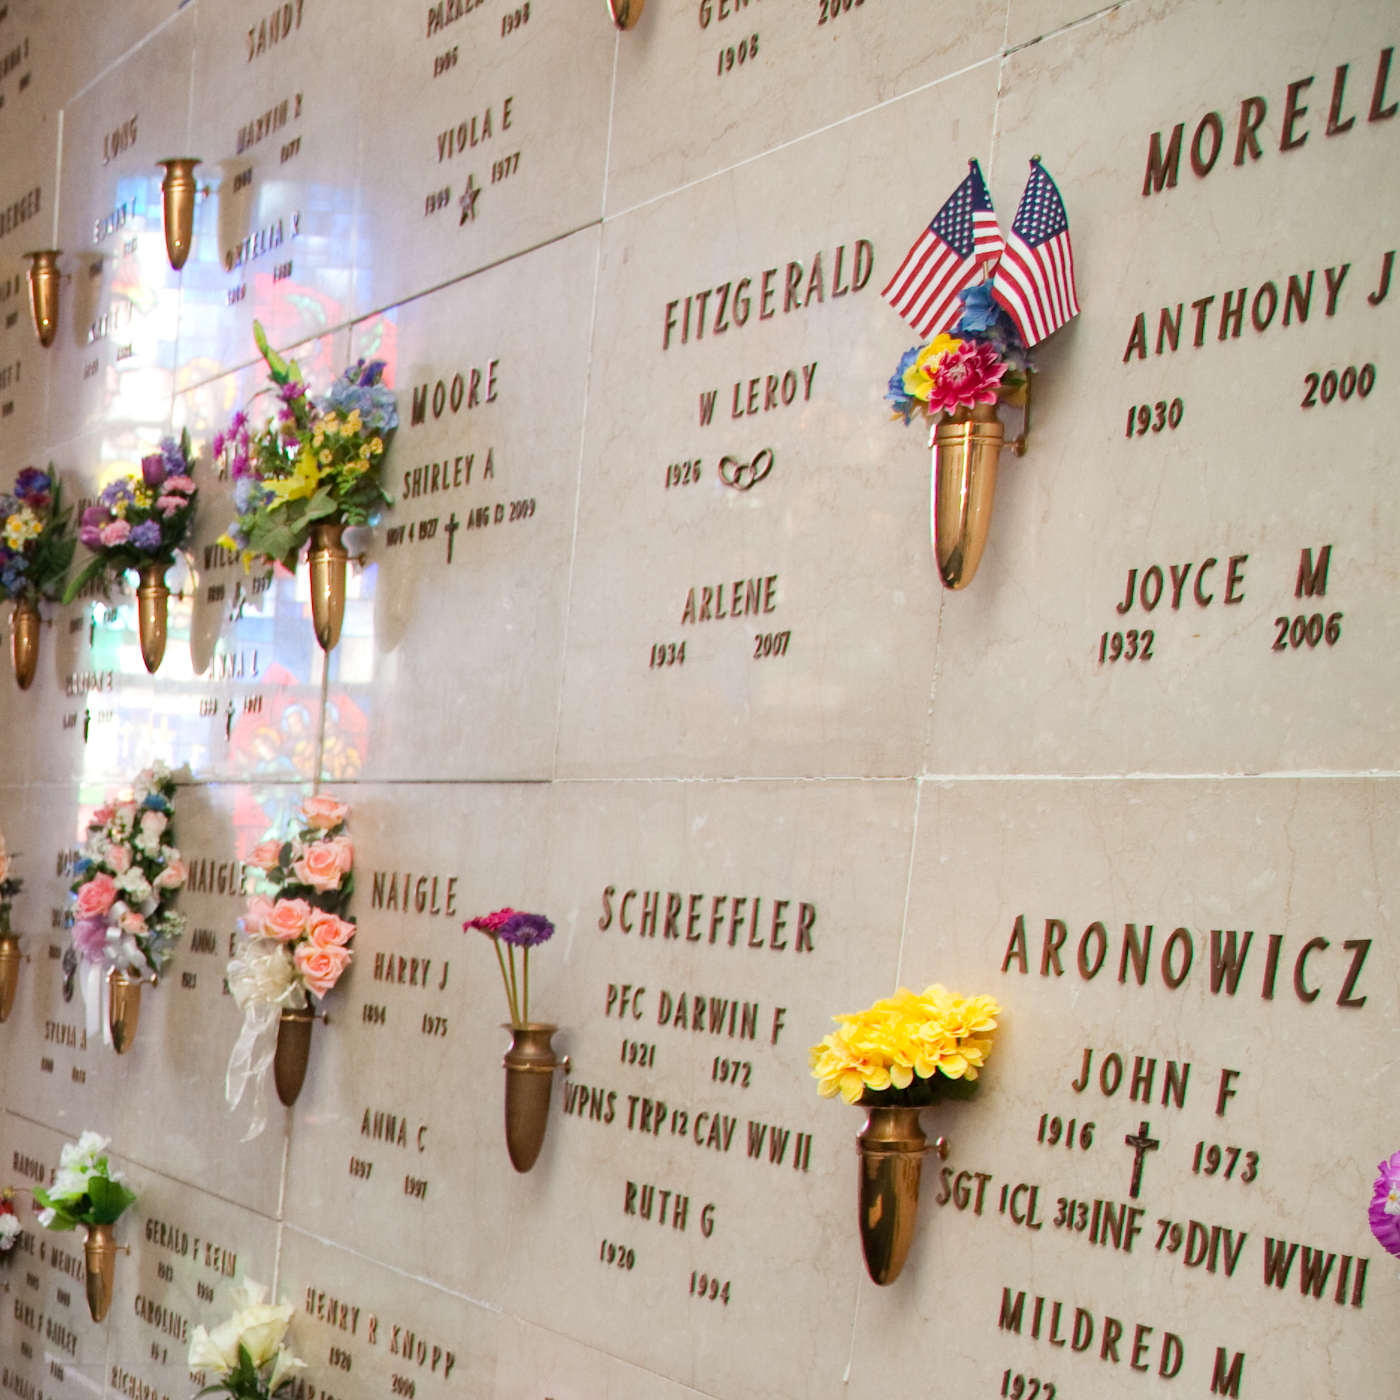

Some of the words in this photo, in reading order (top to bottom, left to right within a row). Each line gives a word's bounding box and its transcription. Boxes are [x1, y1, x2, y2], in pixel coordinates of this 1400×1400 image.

[437, 107, 493, 163] VIOLA
[502, 95, 514, 131] E
[491, 151, 521, 184] 1977
[663, 239, 875, 350] FITZGERALD
[1123, 264, 1350, 362] ANTHONY
[1367, 250, 1397, 304] J
[411, 359, 499, 427] MOORE
[699, 391, 717, 428] W
[730, 362, 818, 420] LEROY
[1303, 363, 1377, 408] 2000
[1125, 398, 1184, 438] 1930
[402, 453, 475, 500] SHIRLEY
[484, 447, 495, 480] A
[665, 460, 701, 489] 1926
[419, 518, 439, 541] 1927
[466, 504, 490, 531] AUG
[509, 497, 537, 521] 2009
[682, 575, 778, 625] ARLENE
[1116, 555, 1248, 614] JOYCE
[1295, 545, 1332, 598] M
[754, 631, 791, 659] 2007
[1099, 630, 1155, 663] 1932
[1272, 613, 1343, 650] 2006
[649, 641, 686, 669] 1934
[371, 872, 458, 917] NAIGLE
[599, 885, 817, 953] SCHREFFLER
[373, 952, 431, 988] HARRY
[438, 961, 450, 992] J
[1000, 914, 1373, 1008] ARONOWICZ
[421, 1013, 448, 1037] 1975
[605, 983, 644, 1020] PFC
[657, 990, 759, 1041] DARWIN
[771, 1006, 787, 1046] F
[620, 1039, 656, 1068] 1921
[711, 1056, 752, 1089] 1972
[1071, 1047, 1191, 1108] JOHN
[1214, 1068, 1241, 1117] F
[360, 1107, 408, 1147] ANNA
[417, 1124, 428, 1152] C
[562, 1080, 617, 1124] WPNS
[628, 1094, 668, 1138] TRP
[670, 1109, 689, 1138] 12
[693, 1112, 737, 1153] CAV
[1036, 1112, 1096, 1150] 1916
[1192, 1140, 1260, 1184] 1973
[623, 1180, 690, 1231] RUTH
[700, 1203, 716, 1238] G
[145, 1217, 189, 1257] GERALD
[192, 1237, 200, 1262] F
[600, 1238, 635, 1270] 1920
[935, 1166, 992, 1215] SGT
[1263, 1236, 1369, 1308] WWII
[689, 1271, 731, 1305] 1994
[134, 1294, 188, 1345] CAROLINE
[305, 1285, 360, 1335] HENRY
[368, 1313, 378, 1345] R
[390, 1324, 456, 1380] KNOPP
[998, 1286, 1184, 1379] MILDRED
[1210, 1346, 1246, 1400] M
